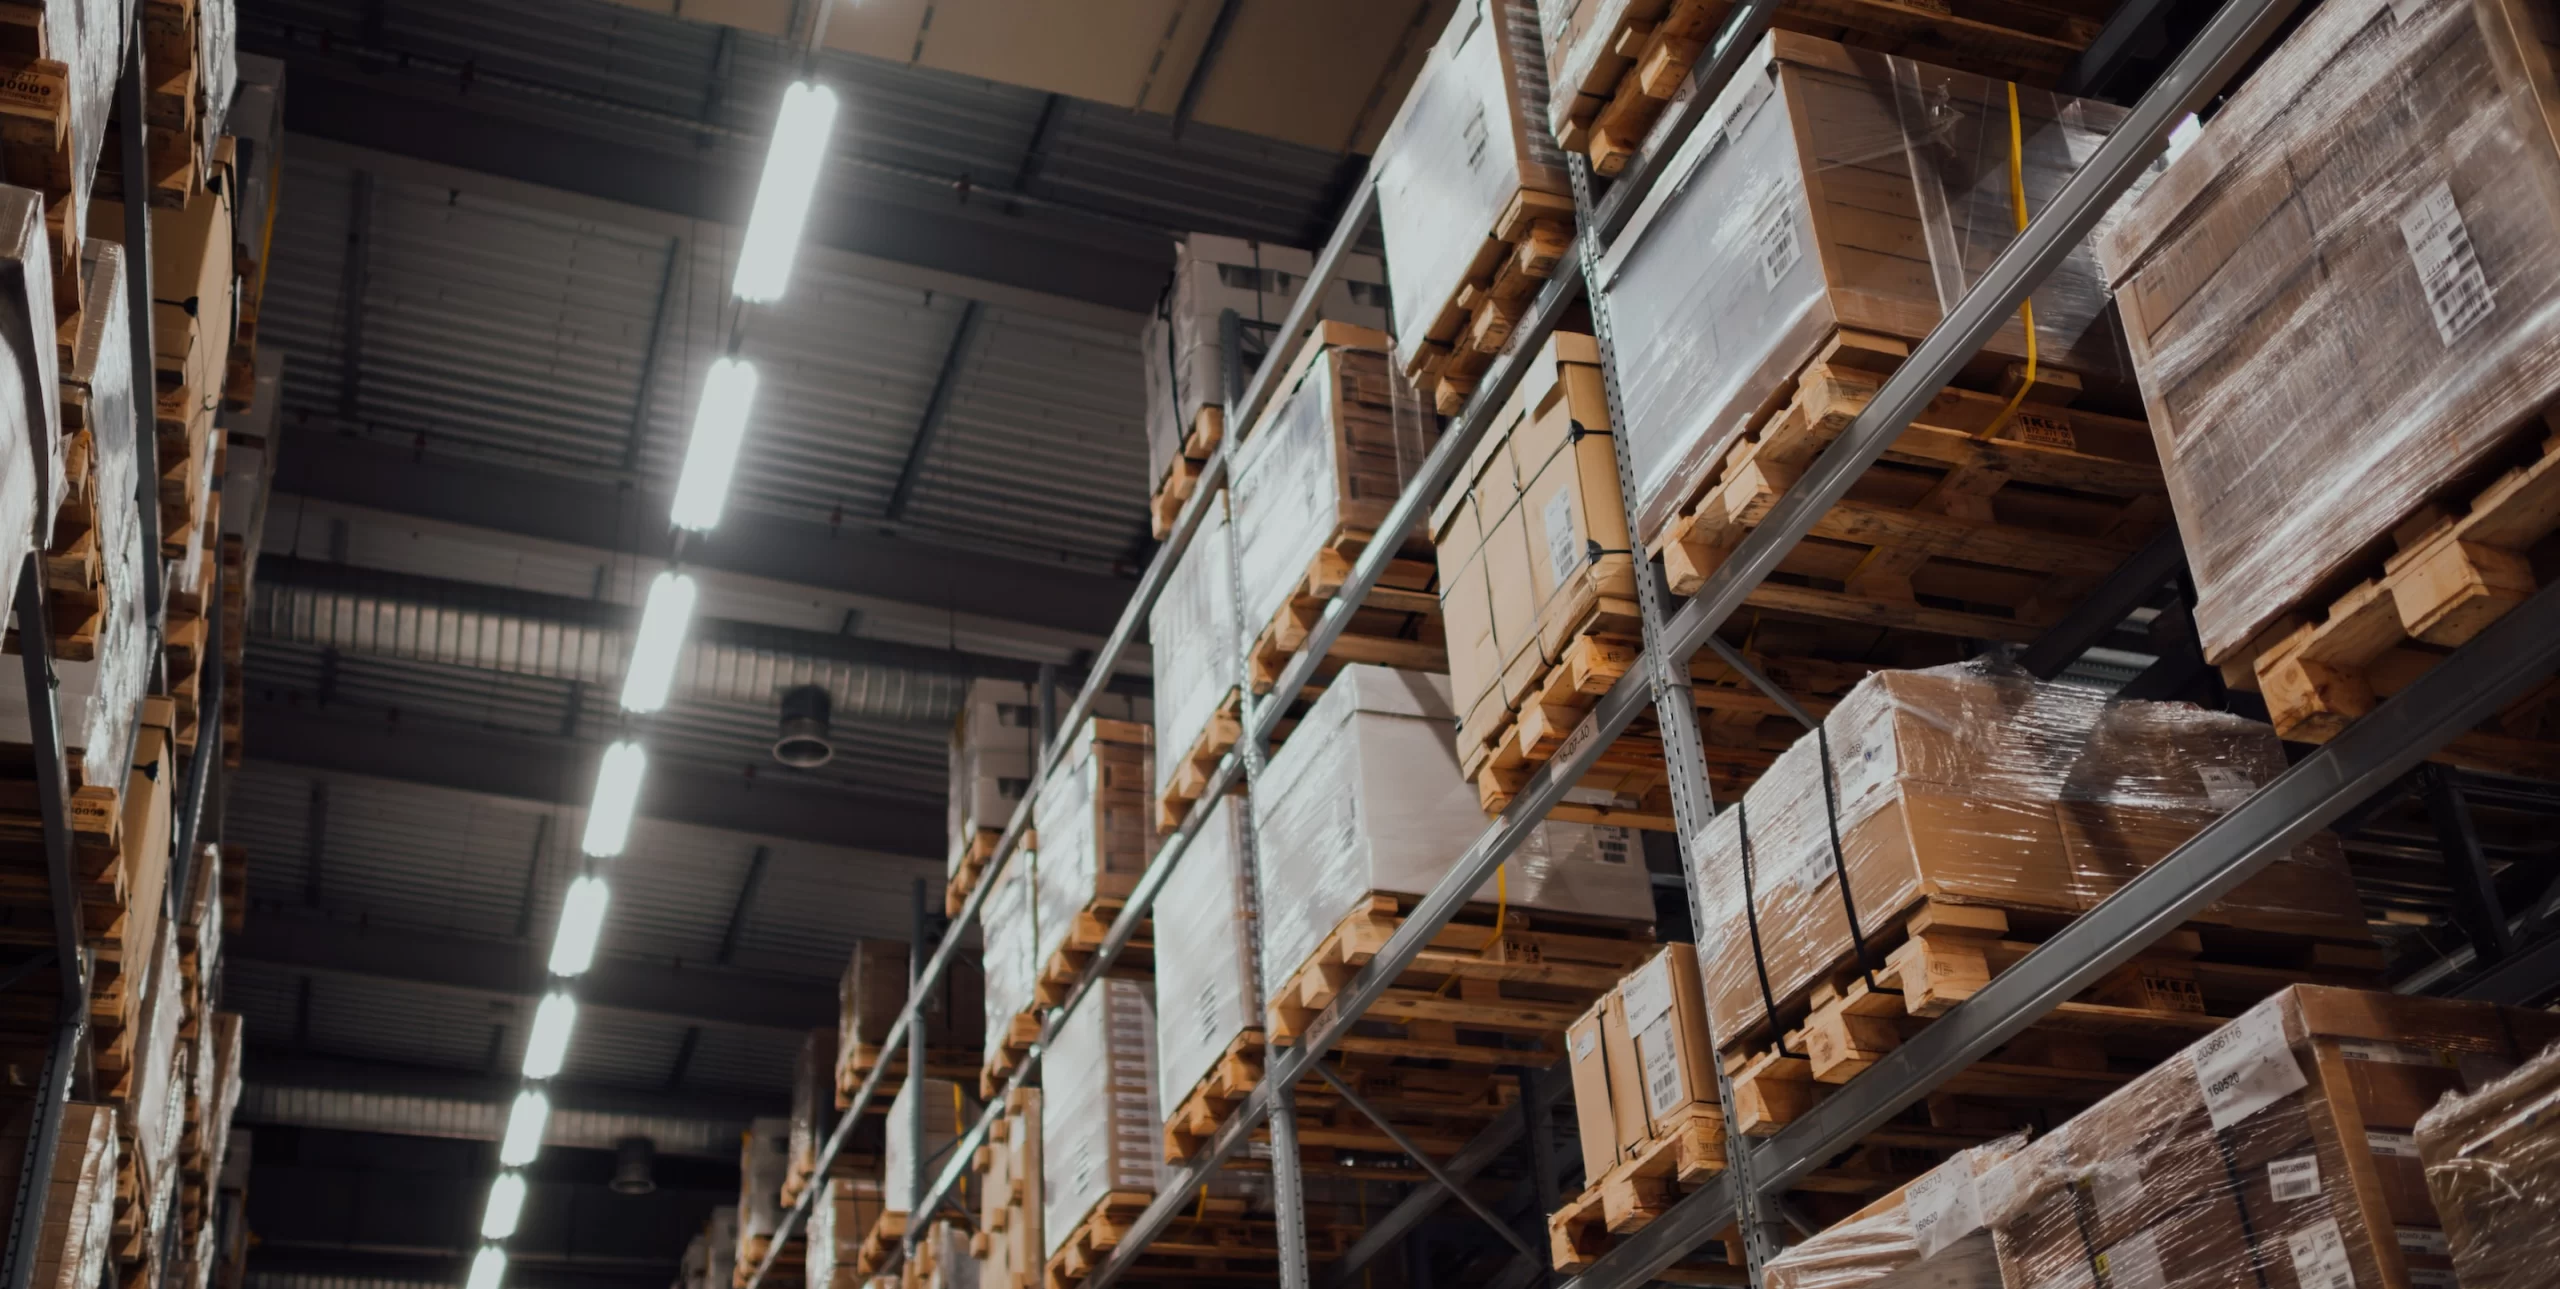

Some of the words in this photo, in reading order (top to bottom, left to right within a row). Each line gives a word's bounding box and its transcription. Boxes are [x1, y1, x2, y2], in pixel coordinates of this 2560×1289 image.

[2146, 978, 2198, 995] IKEA
[2196, 1026, 2242, 1061] 20366116
[2207, 1072, 2240, 1097] 160520
[1909, 1172, 1942, 1200] 10452713
[1915, 1211, 1938, 1232] 160620
